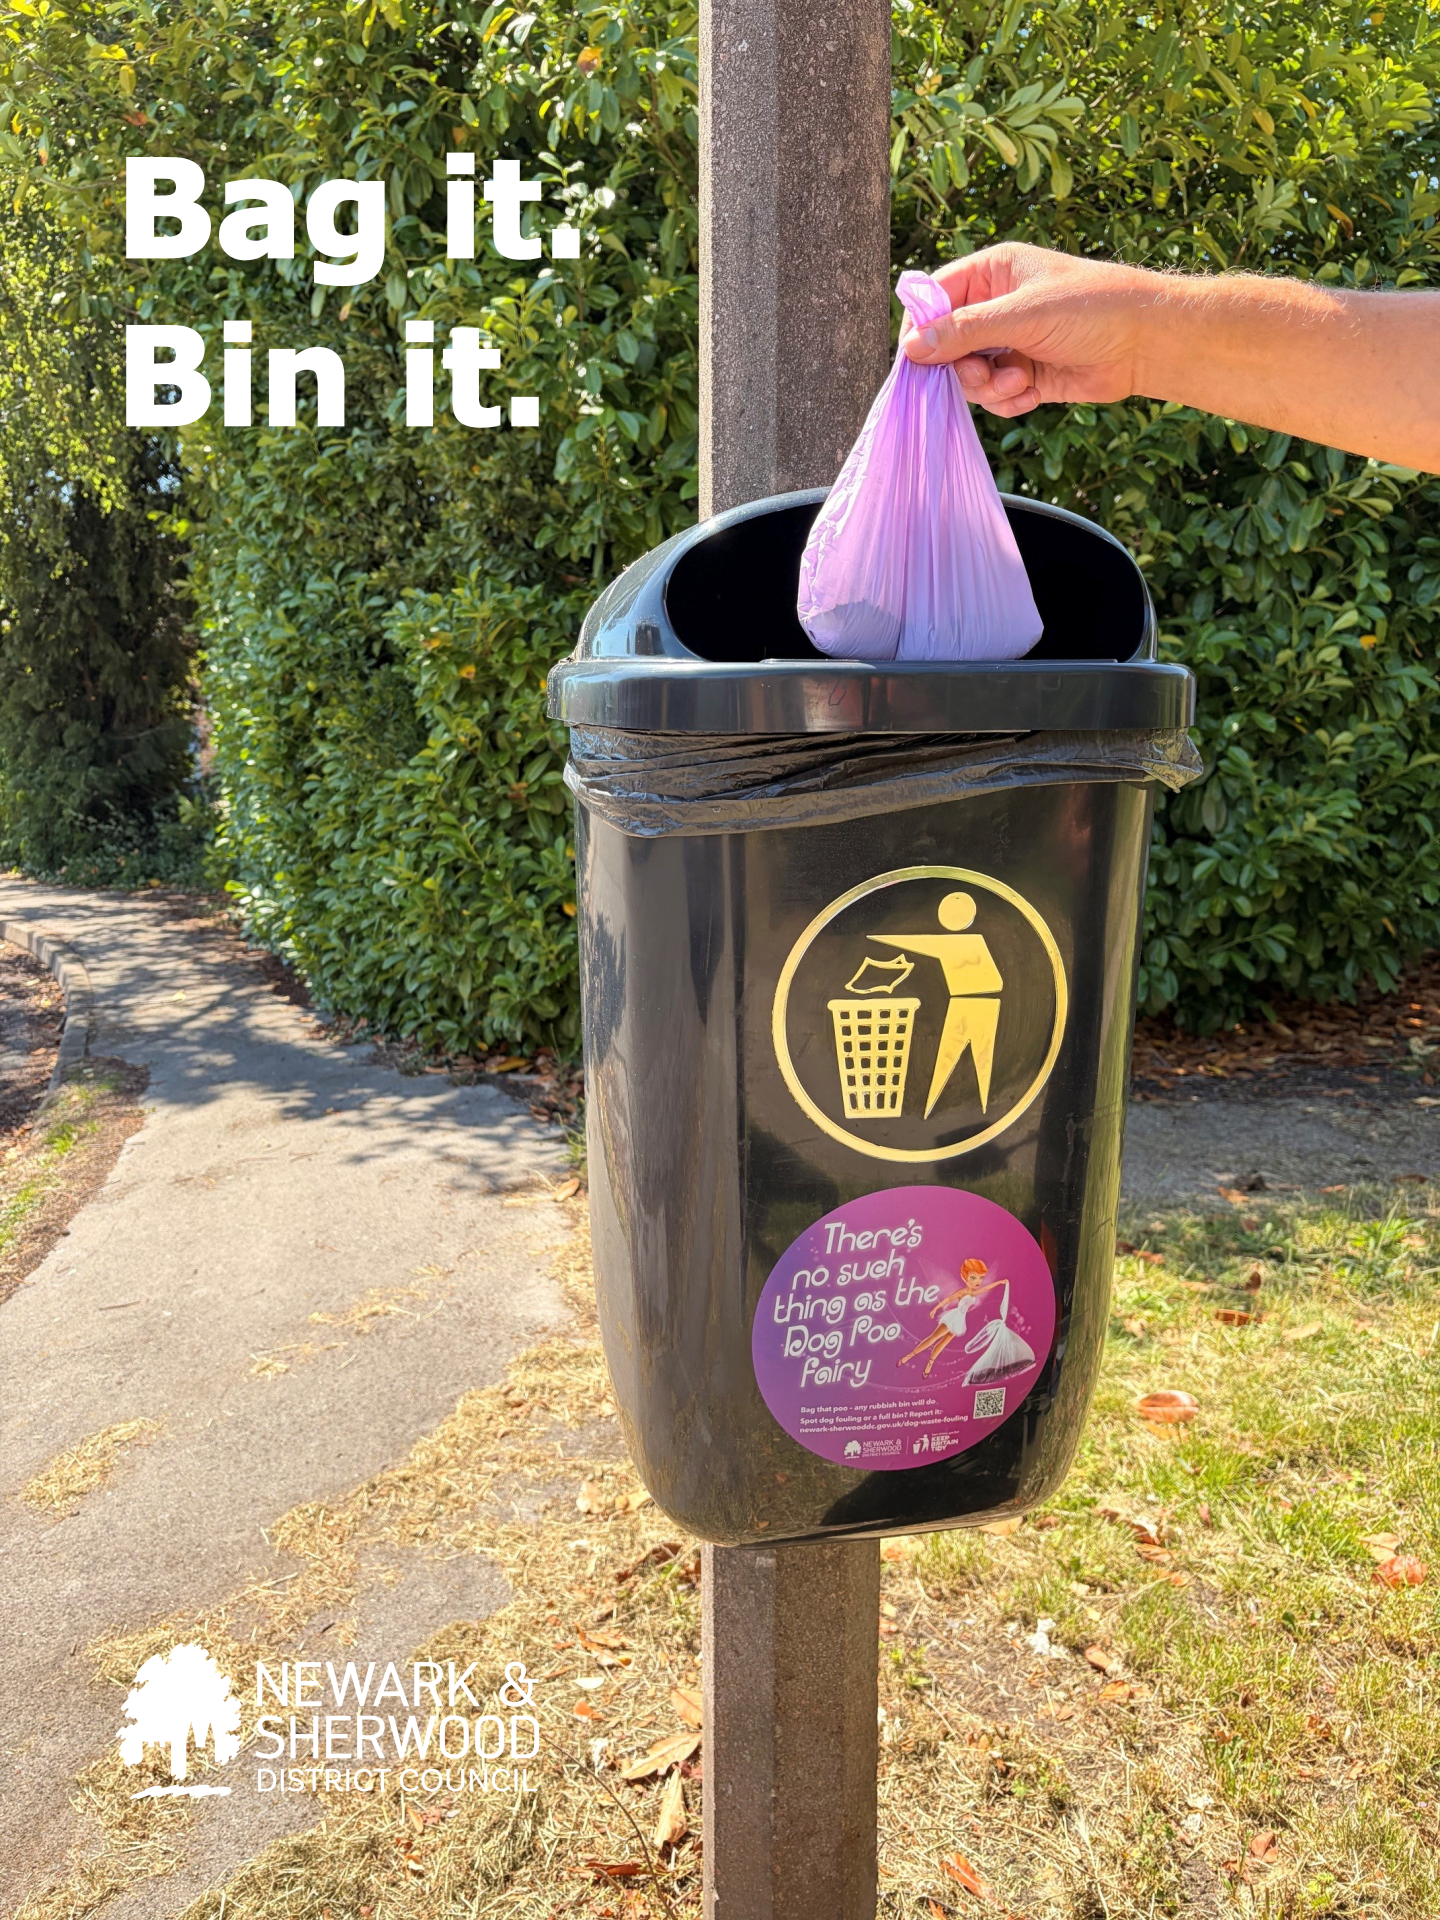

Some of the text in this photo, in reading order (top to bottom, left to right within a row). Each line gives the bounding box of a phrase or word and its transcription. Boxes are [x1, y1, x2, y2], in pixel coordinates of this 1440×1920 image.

[824, 1218, 923, 1255] There's
[791, 1248, 905, 1291] no such
[773, 1276, 941, 1324] thing as the
[783, 1314, 901, 1359] Dog Poo
[800, 1356, 872, 1388] fairy
[800, 1406, 816, 1415] Bag
[816, 1405, 832, 1413] that
[832, 1406, 848, 1414] poo
[853, 1404, 868, 1412] any
[868, 1401, 897, 1410] rubbish
[898, 1400, 911, 1408] bin
[911, 1399, 925, 1407] will
[799, 1415, 969, 1433] newark-sherwooddc.gov.uk/dog-waste-fouling
[800, 1417, 818, 1426] Spot
[818, 1416, 834, 1425] dog
[835, 1415, 862, 1423] fouling
[878, 1412, 891, 1420] full
[891, 1411, 908, 1419] bin?
[908, 1409, 934, 1418] Report
[863, 1438, 902, 1447] NEWARK &
[930, 1439, 959, 1447] BRITAIN
[931, 1435, 950, 1443] KEEP
[862, 1445, 902, 1454] SHERWOOD
